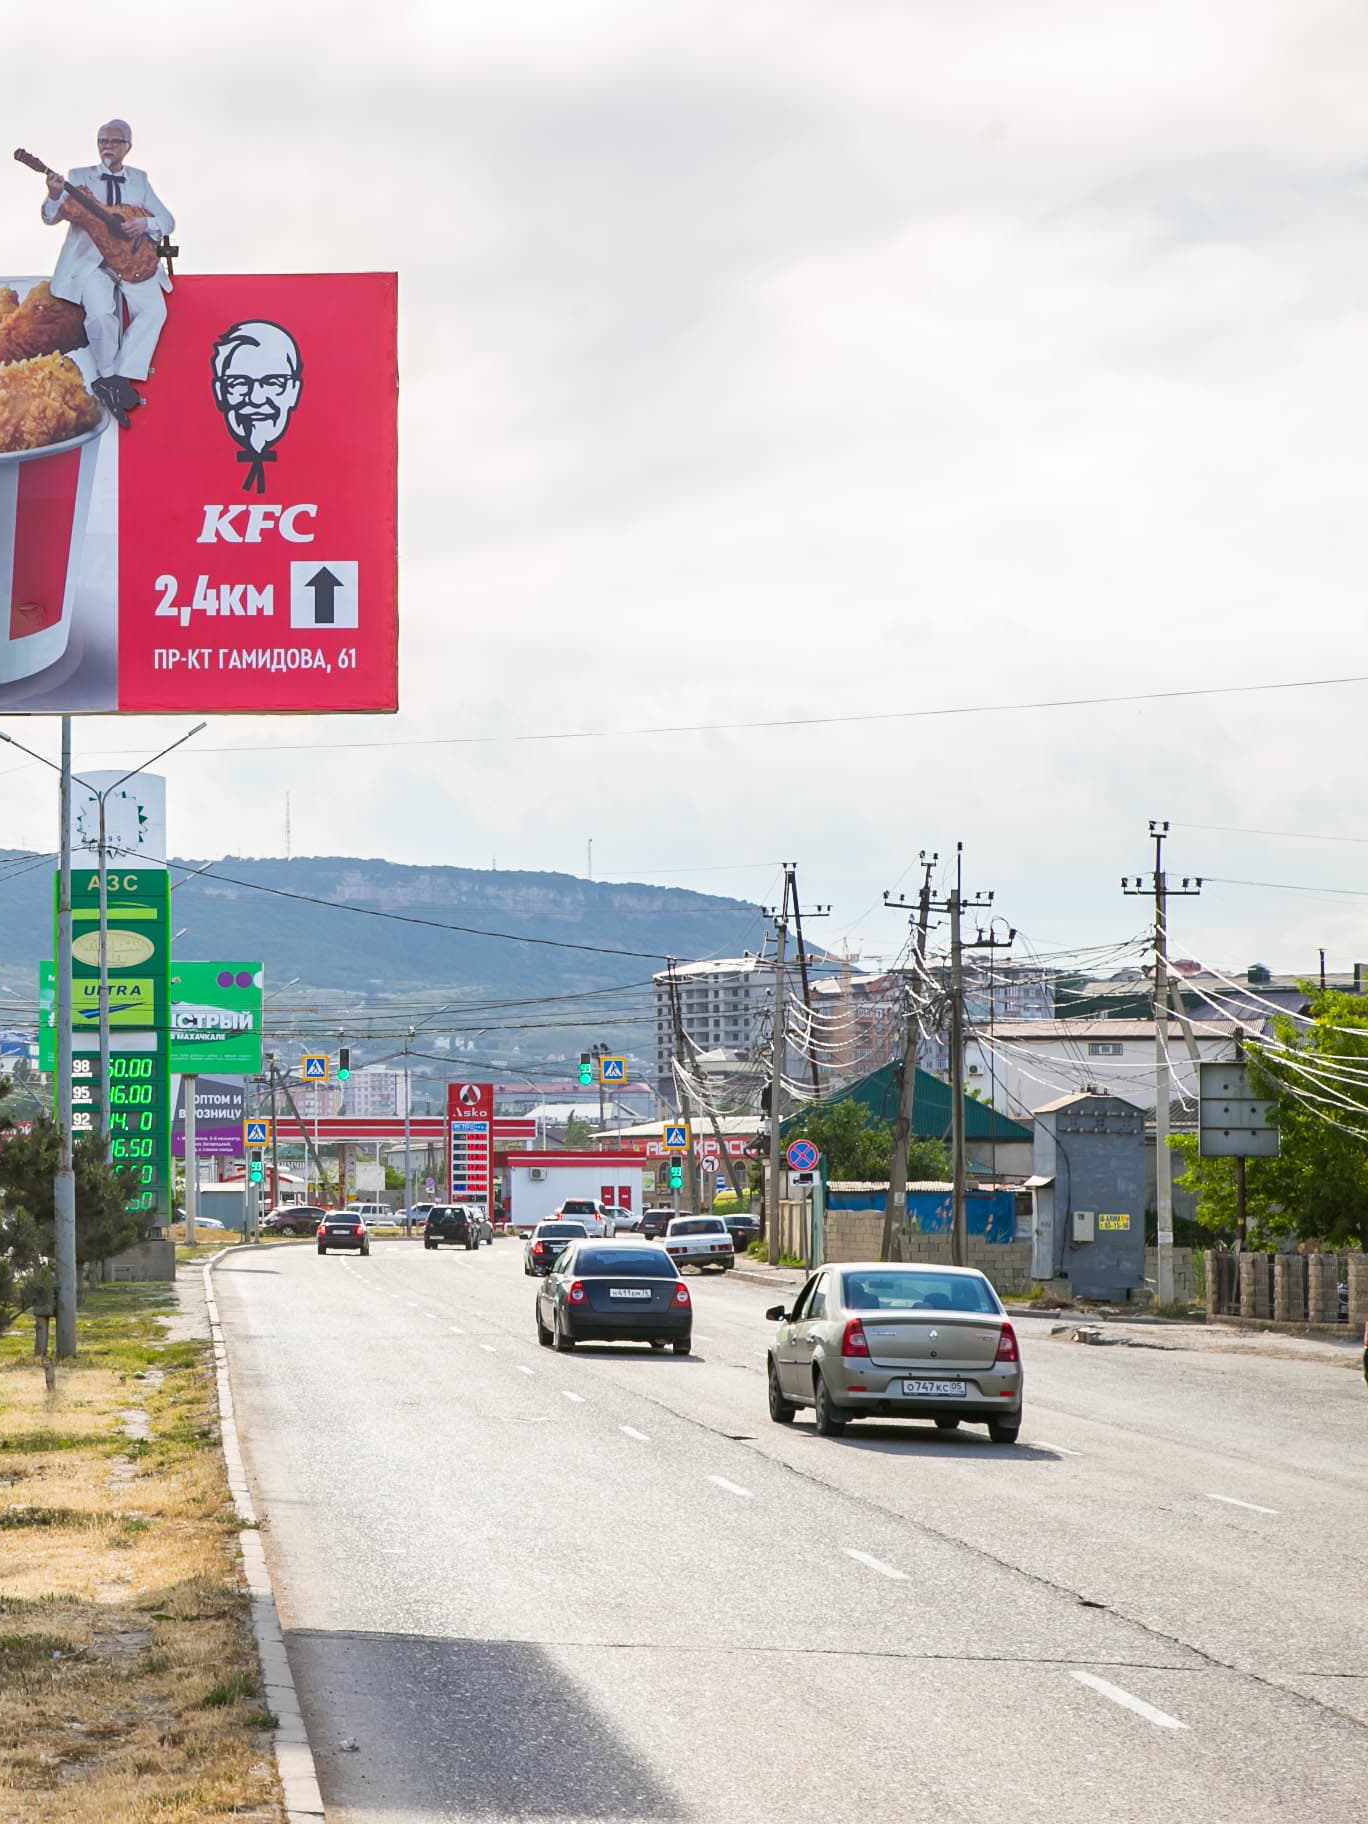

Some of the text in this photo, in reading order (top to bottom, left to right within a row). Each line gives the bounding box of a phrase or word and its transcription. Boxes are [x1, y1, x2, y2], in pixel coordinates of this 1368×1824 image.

[195, 504, 317, 543] KFC
[154, 575, 274, 627] 2,4км
[154, 648, 357, 673] ПР-КТ ГАМИДОВА, 61
[72, 1059, 90, 1072] 98
[72, 1086, 90, 1099] 95
[233, 1094, 242, 1105] И
[72, 1113, 90, 1125] 92
[951, 1382, 962, 1391] 05
